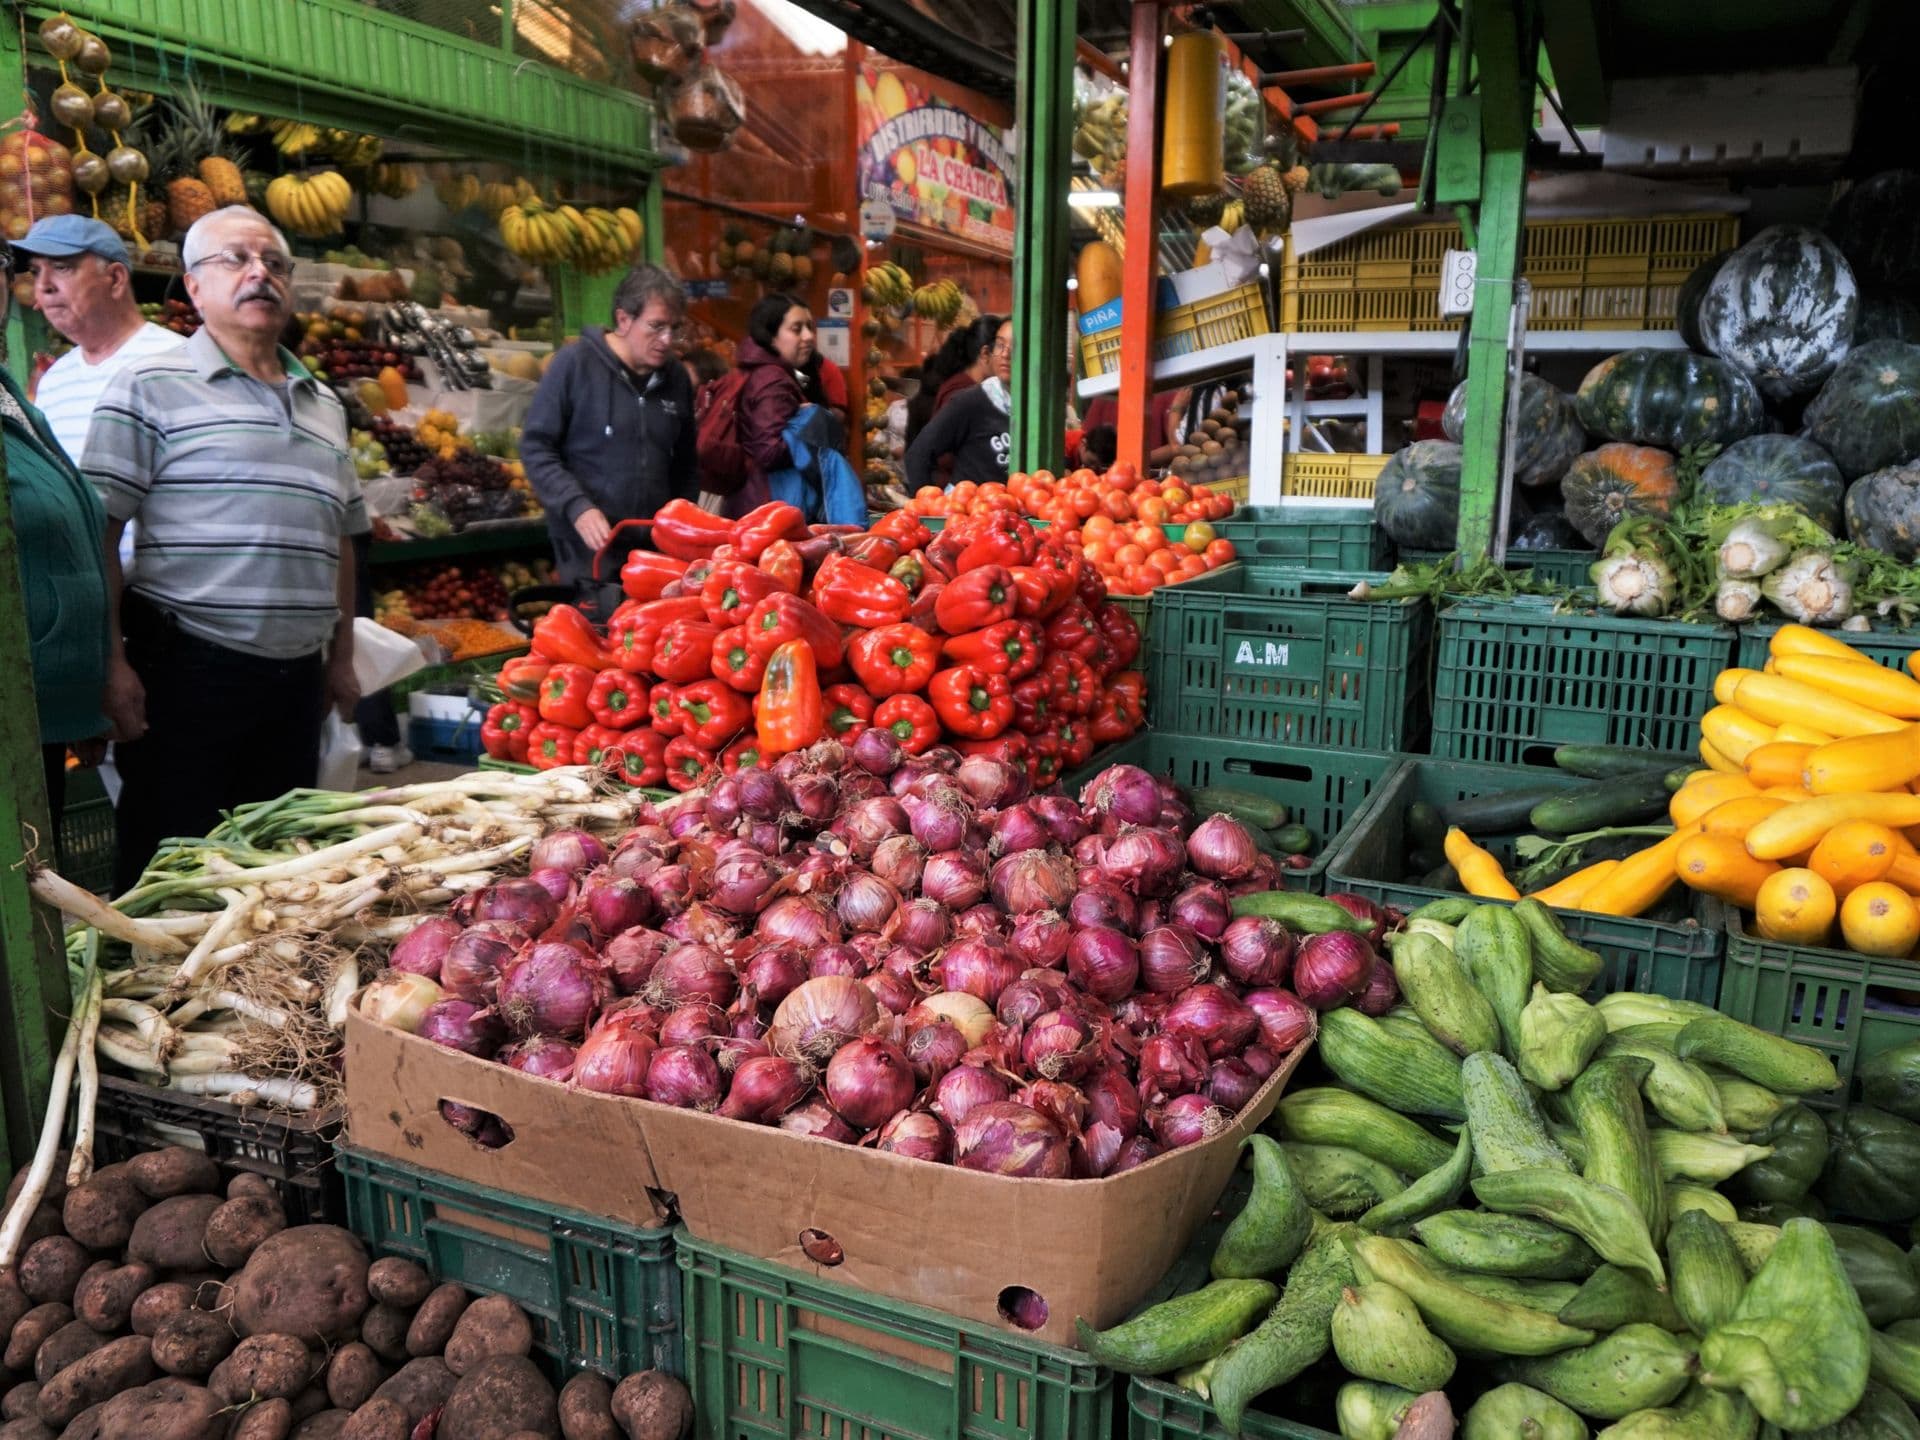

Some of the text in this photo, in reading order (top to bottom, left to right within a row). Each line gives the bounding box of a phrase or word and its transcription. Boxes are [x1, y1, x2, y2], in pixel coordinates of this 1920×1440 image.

[918, 148, 940, 182] LA
[990, 431, 1011, 452] GO
[1234, 640, 1289, 666] A.M
